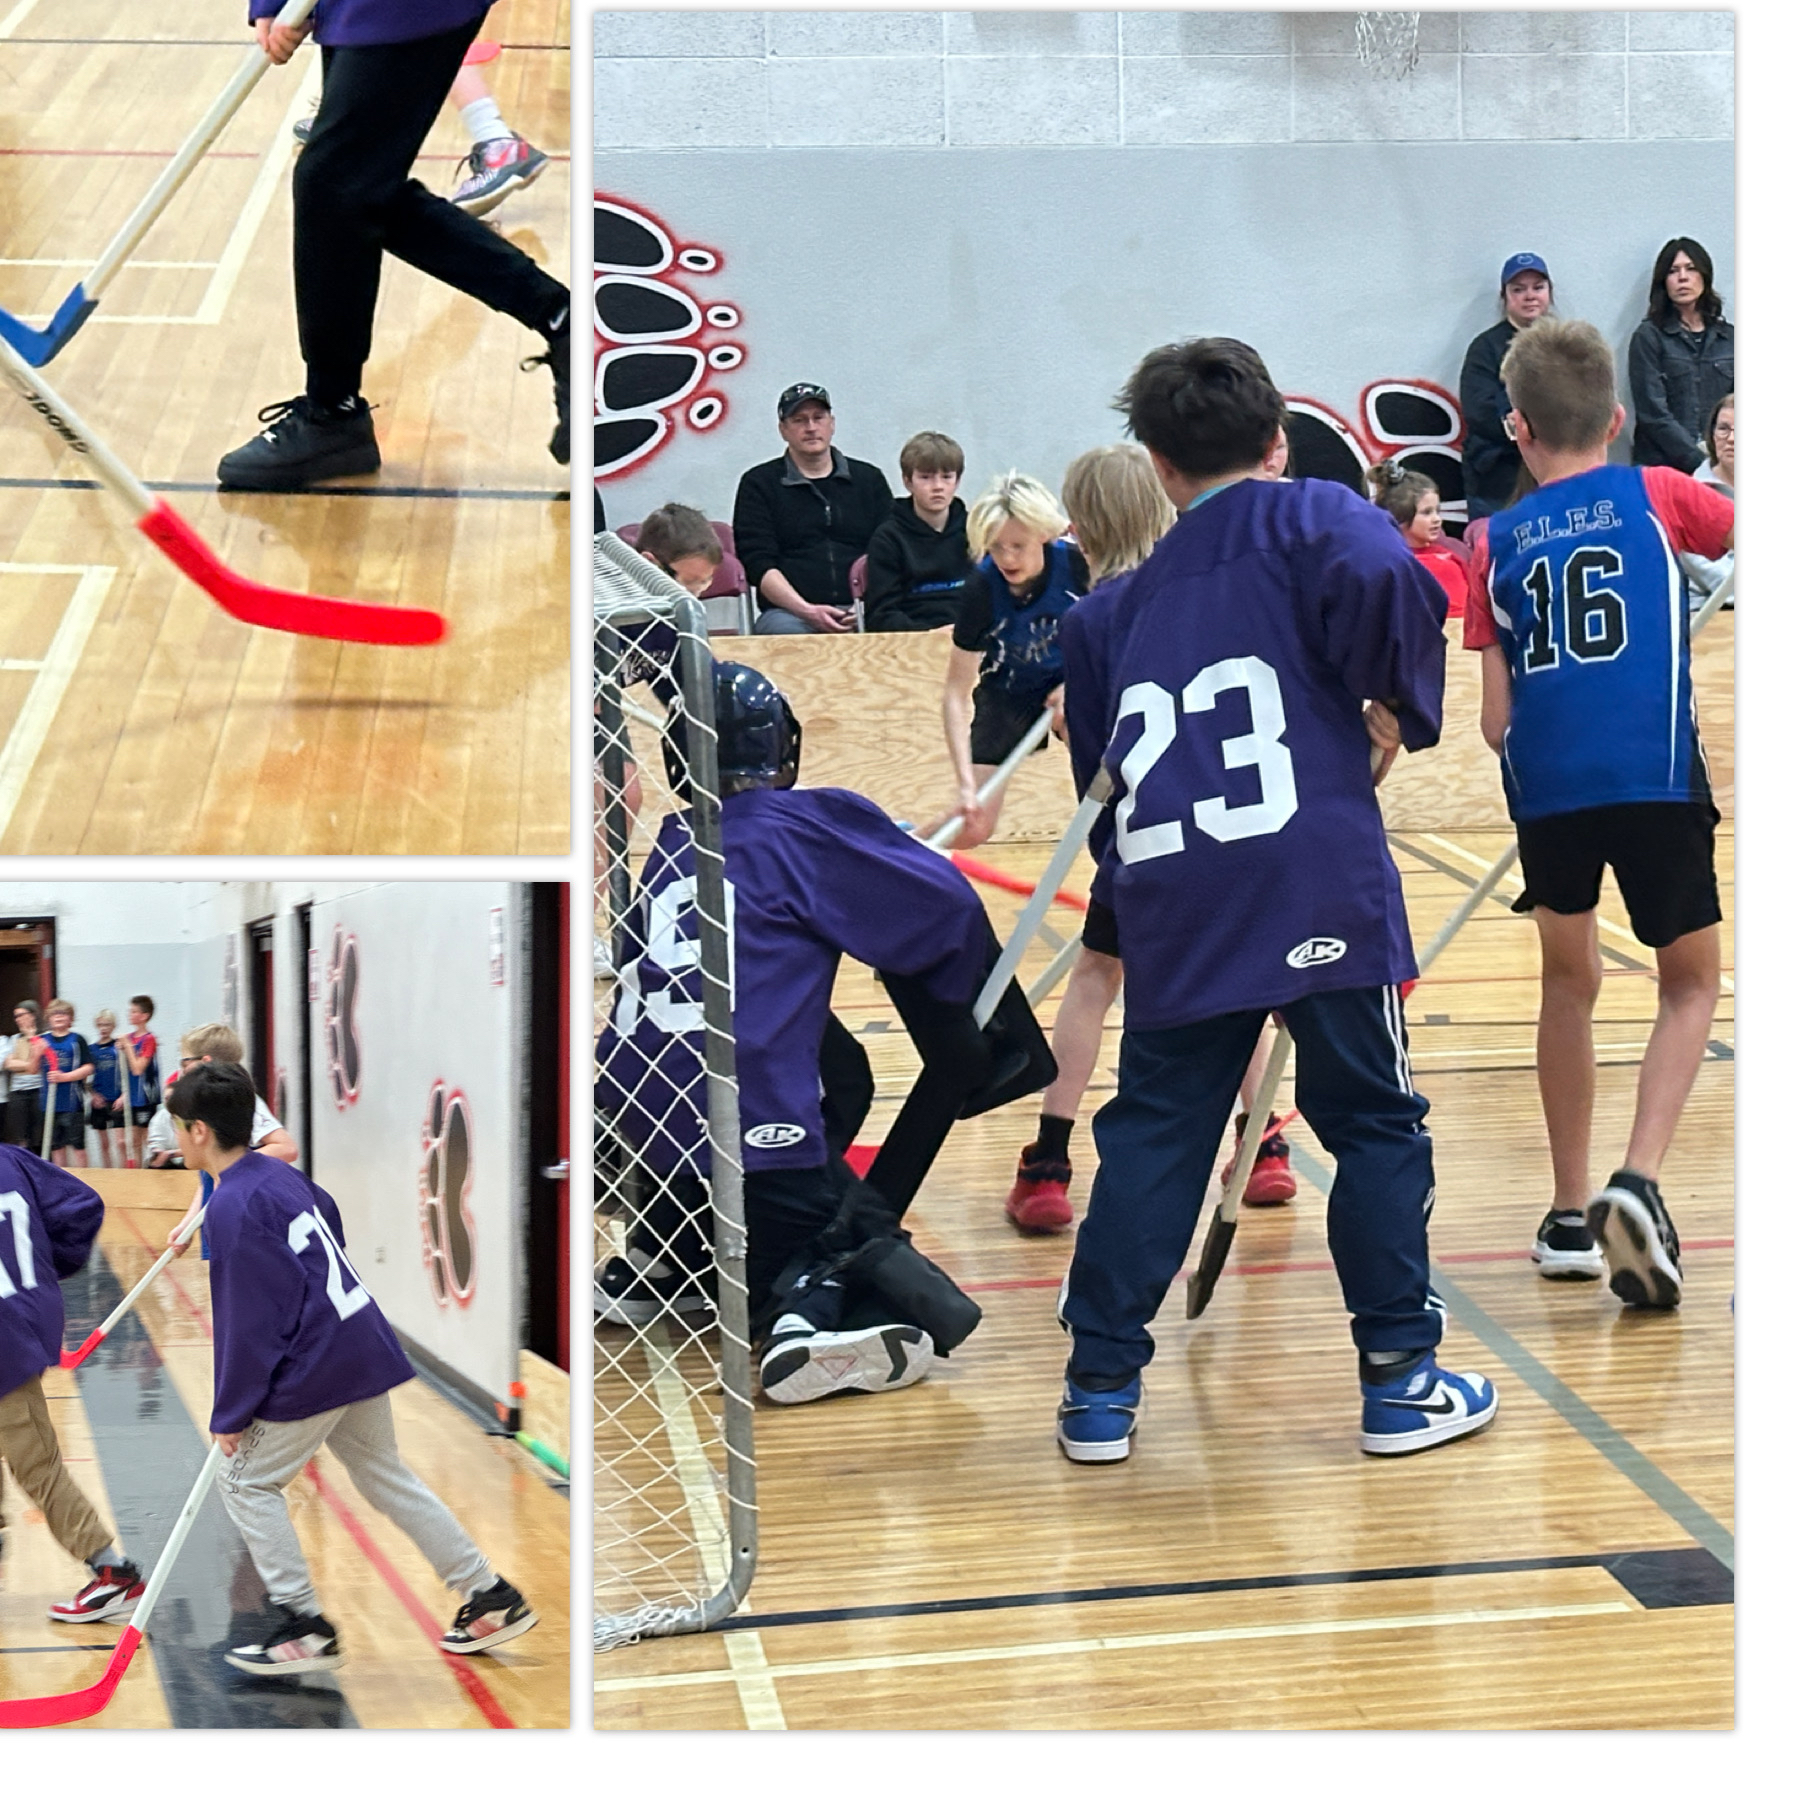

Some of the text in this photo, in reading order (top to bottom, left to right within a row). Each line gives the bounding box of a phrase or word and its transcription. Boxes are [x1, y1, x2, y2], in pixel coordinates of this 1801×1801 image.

[1522, 545, 1629, 674] 16
[1109, 655, 1299, 866] 23
[1289, 939, 1345, 966] AK
[748, 1125, 803, 1146] AK
